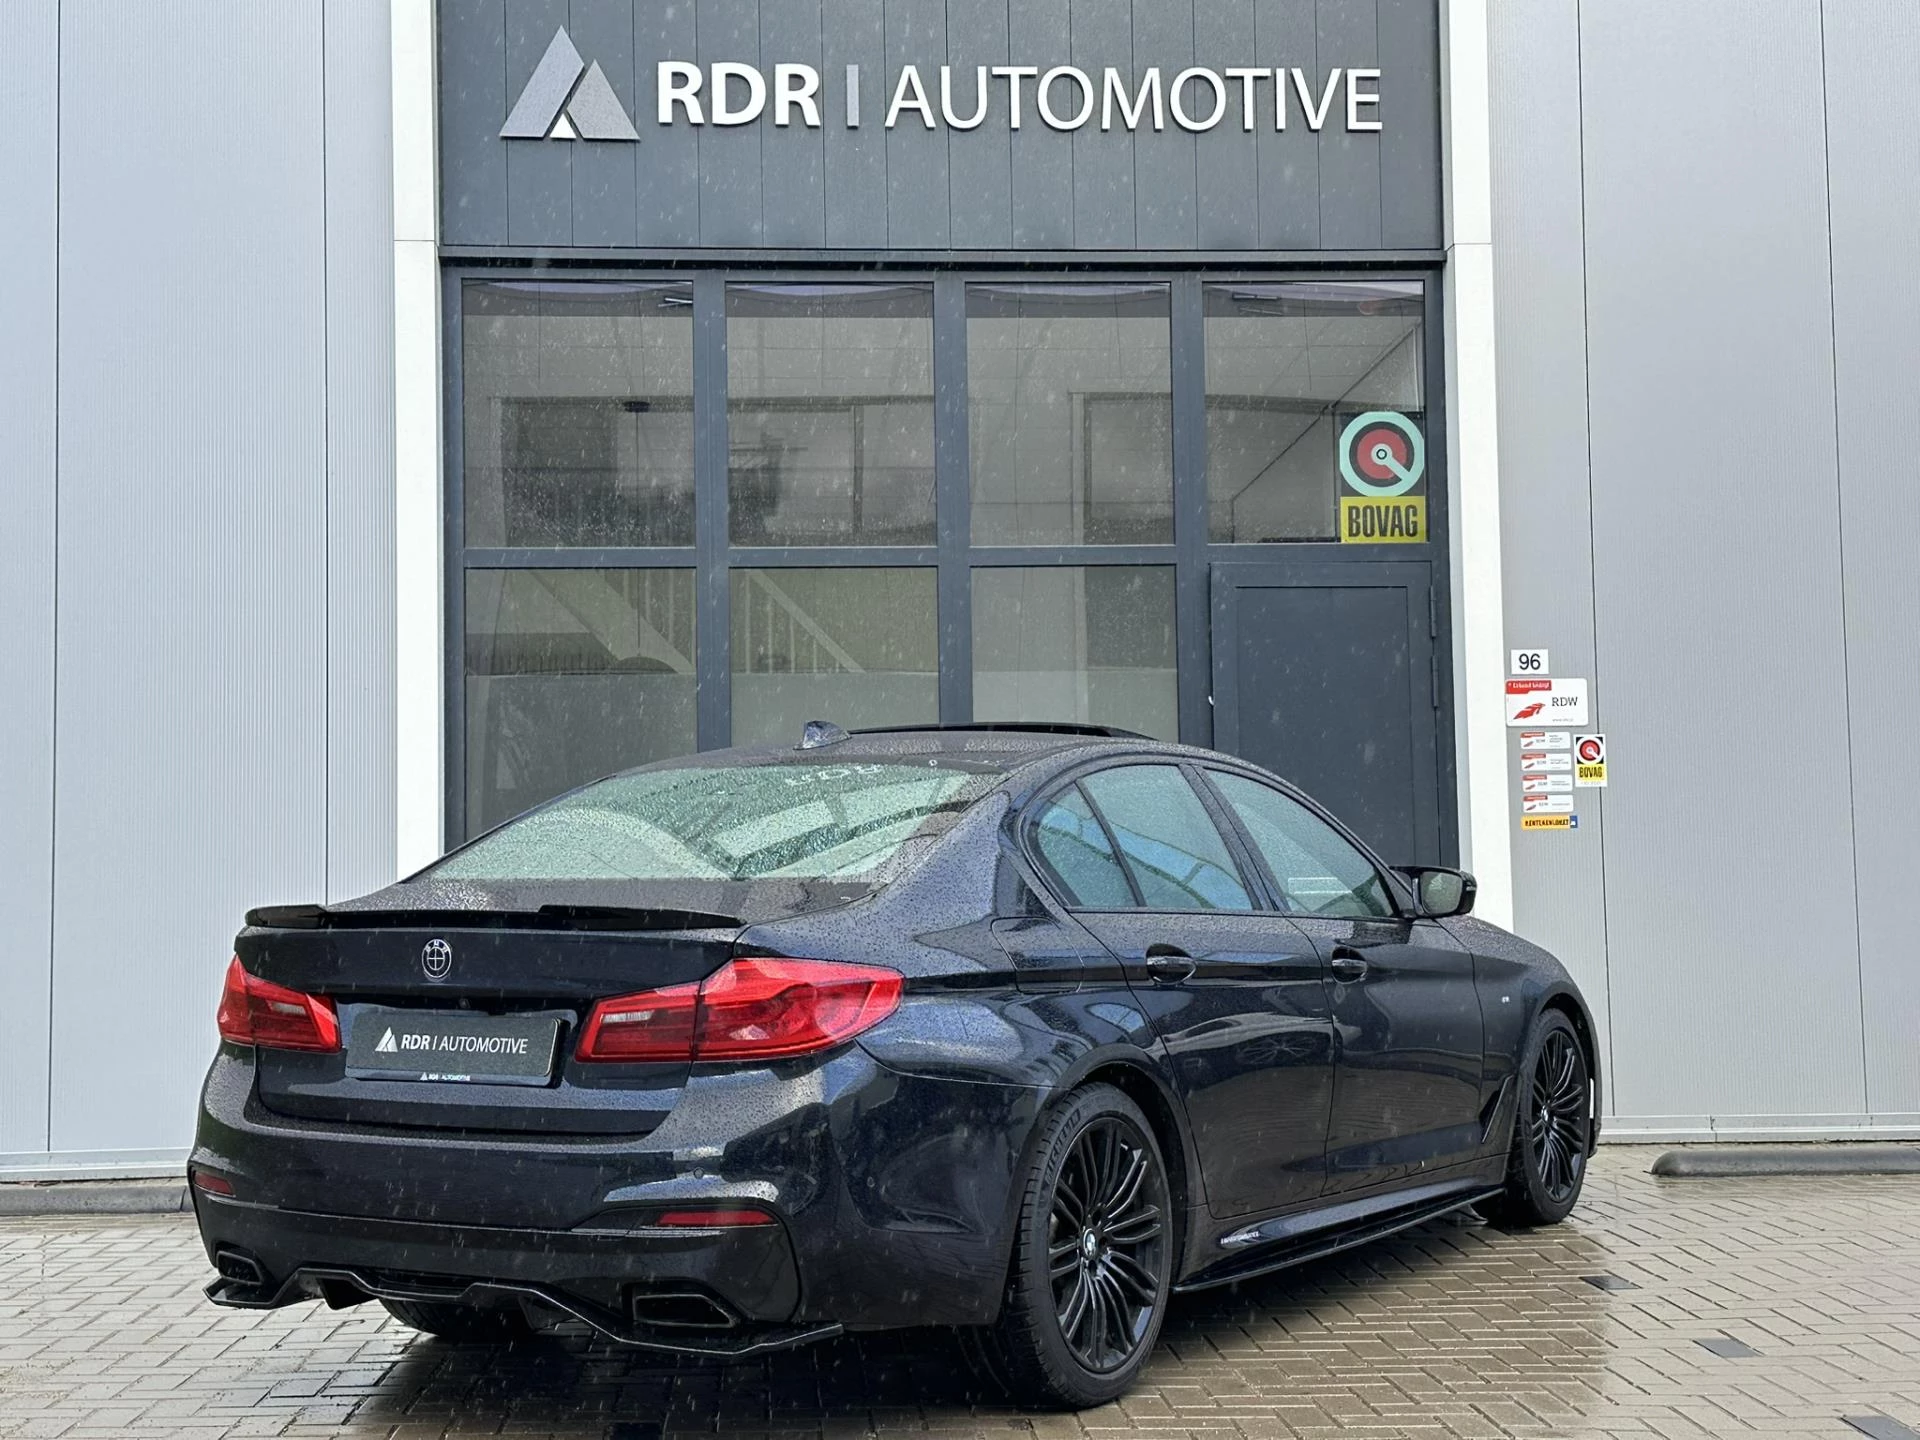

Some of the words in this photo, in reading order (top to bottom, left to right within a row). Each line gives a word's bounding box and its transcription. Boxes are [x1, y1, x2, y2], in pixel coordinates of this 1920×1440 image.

[657, 61, 821, 127] RDR
[884, 64, 1384, 131] AUTOMOTIVE
[1347, 504, 1418, 538] BOVAG
[1519, 653, 1541, 671] 96
[1551, 696, 1578, 707] RDW
[1579, 766, 1603, 778] BOVAG
[401, 1034, 430, 1050] RDR
[439, 1036, 528, 1054] AUTOMOTIVE
